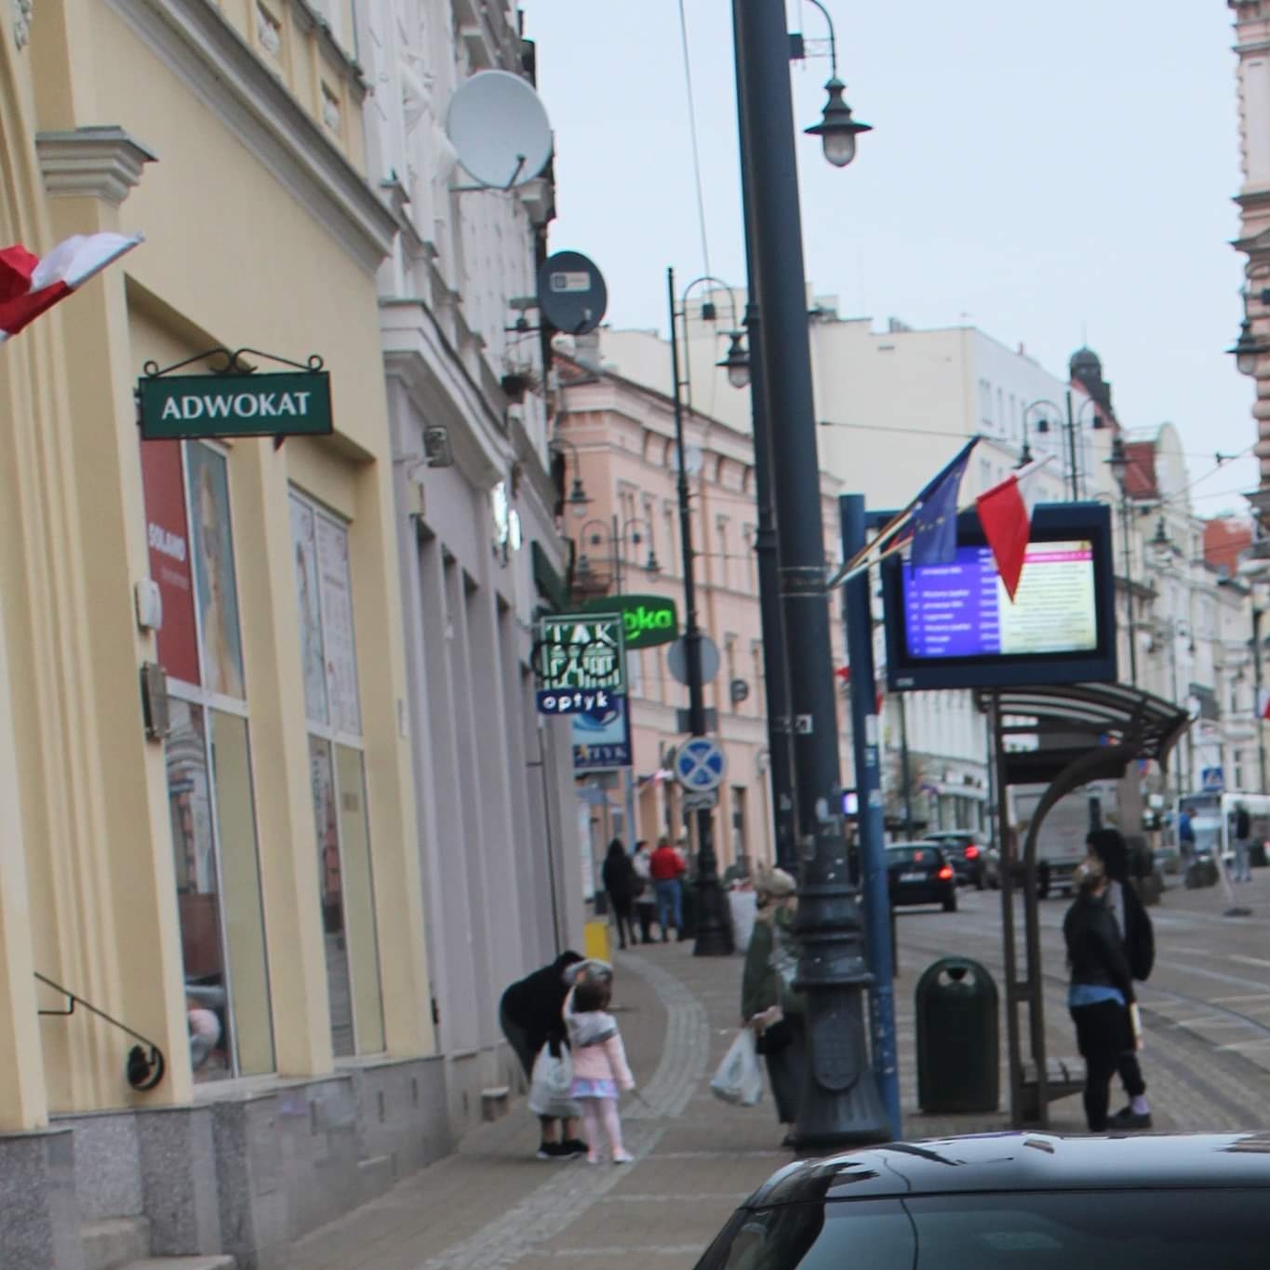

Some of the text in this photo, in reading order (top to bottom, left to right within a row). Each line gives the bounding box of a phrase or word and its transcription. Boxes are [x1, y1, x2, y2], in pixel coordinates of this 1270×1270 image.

[161, 391, 310, 420] ADWOKAT
[546, 624, 618, 648] TAK
[543, 691, 609, 712] optyk
